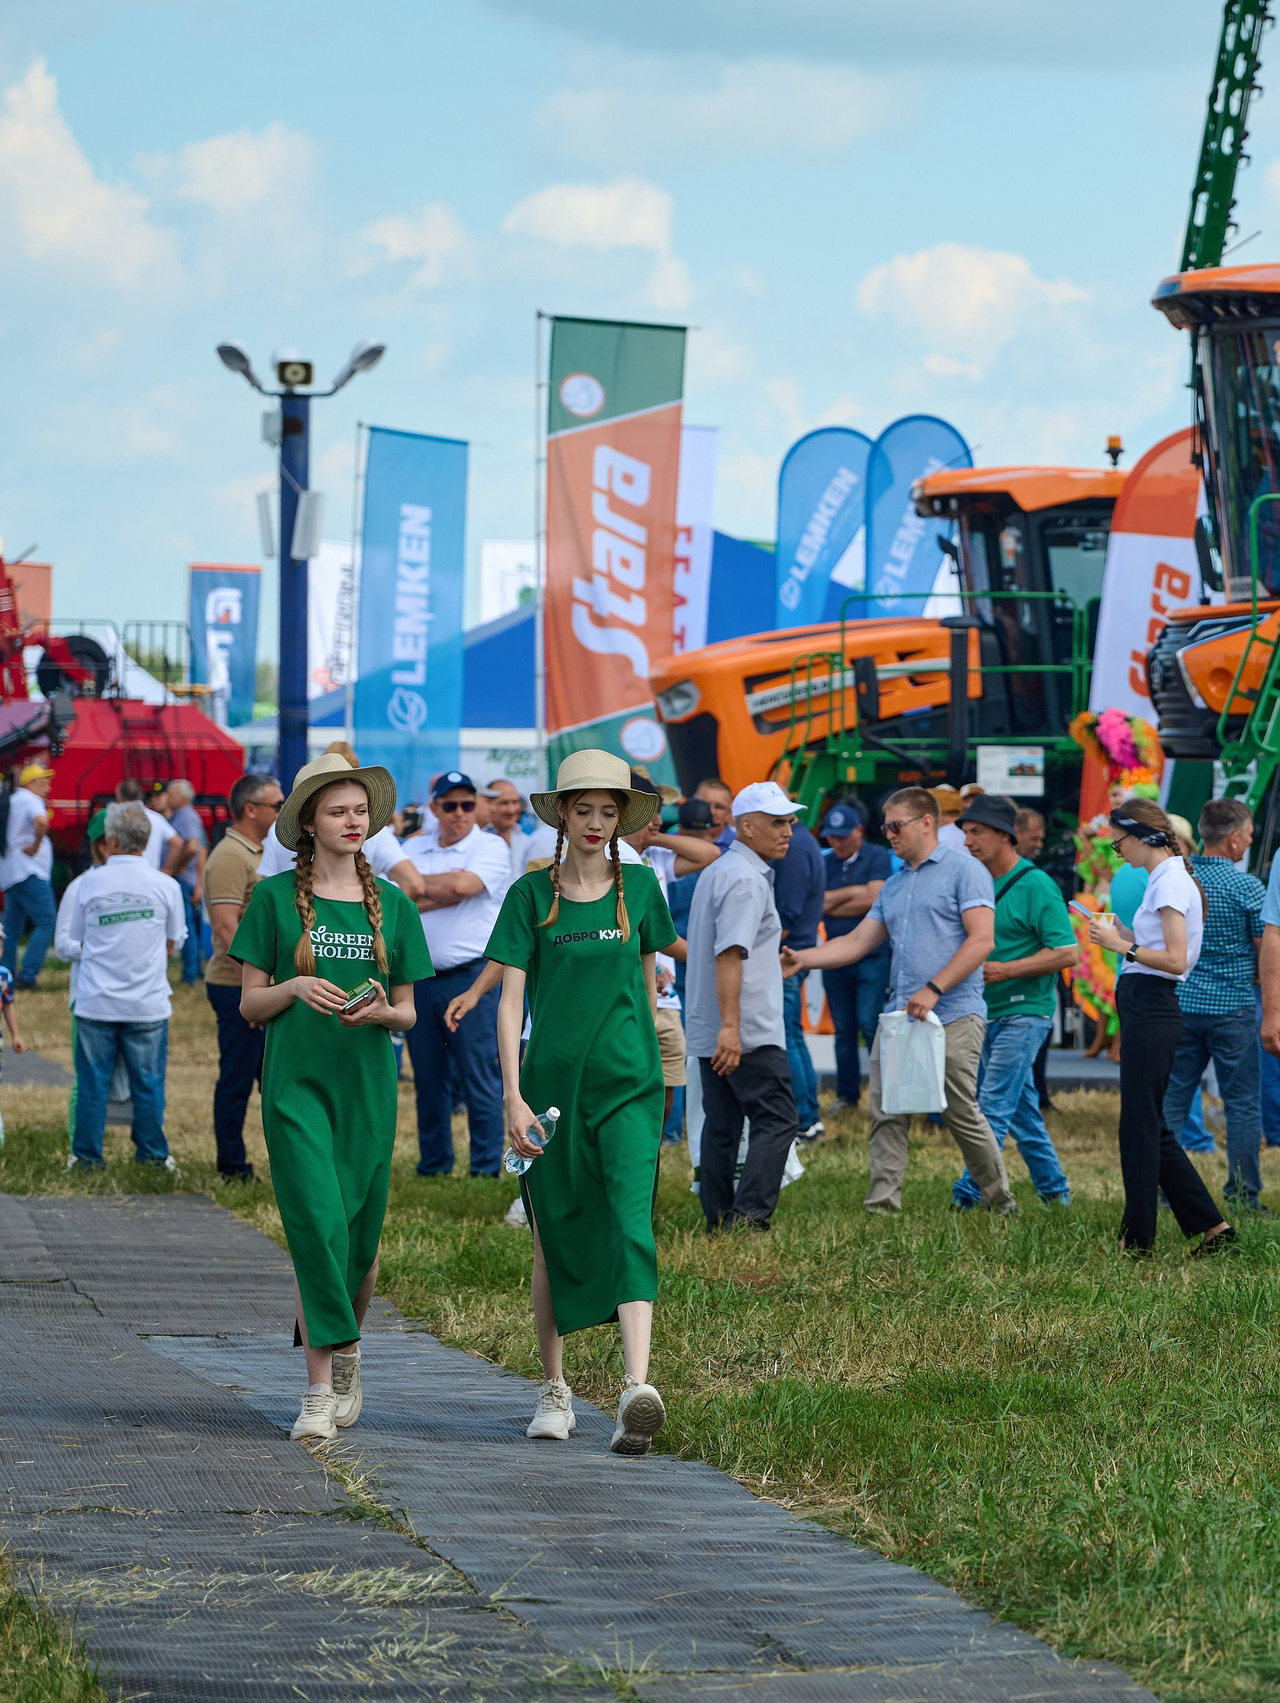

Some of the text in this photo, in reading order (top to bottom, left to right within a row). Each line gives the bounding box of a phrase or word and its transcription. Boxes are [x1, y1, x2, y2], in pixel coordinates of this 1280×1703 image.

[392, 503, 433, 685] LEMKEN
[572, 444, 651, 678] Stara
[789, 467, 858, 582] LEMKEN
